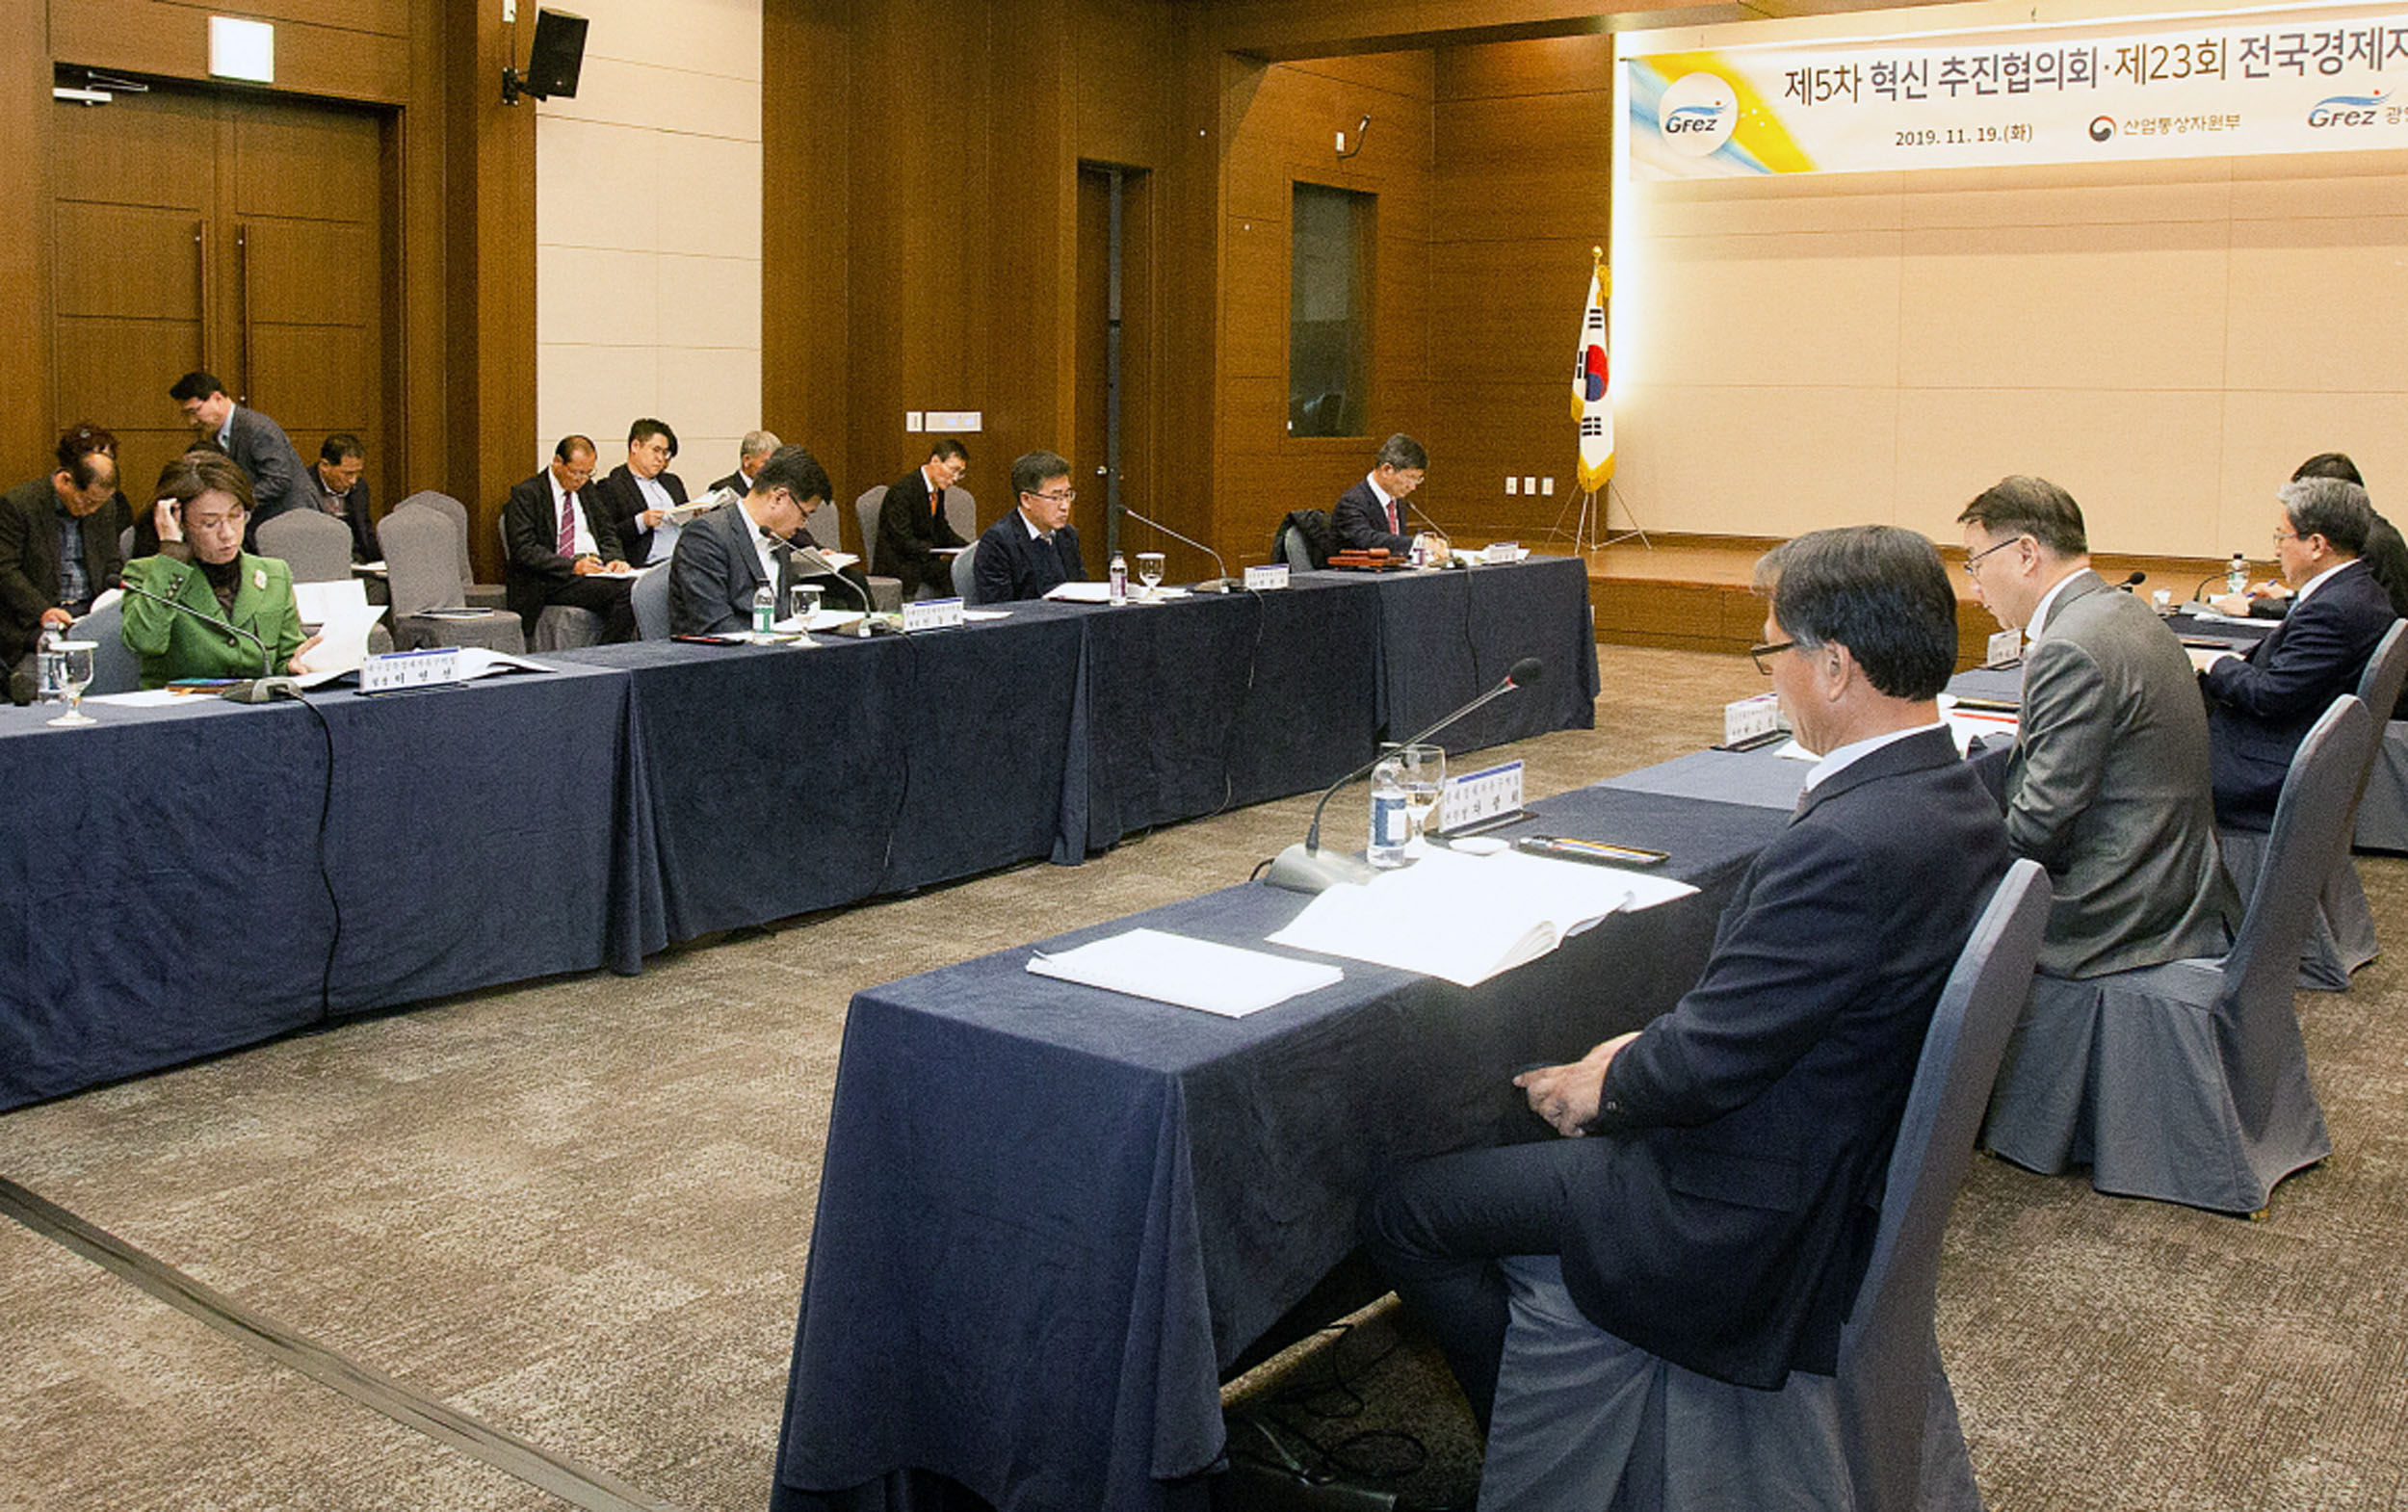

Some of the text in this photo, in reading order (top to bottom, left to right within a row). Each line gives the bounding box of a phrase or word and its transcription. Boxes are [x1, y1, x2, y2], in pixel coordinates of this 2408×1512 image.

[1784, 63, 1863, 106] 제5차
[1870, 58, 1928, 102] 혁신
[2123, 114, 2241, 136] 산업통상자원부
[2386, 106, 2408, 125] 광
[1895, 129, 1940, 146] 2019.
[1946, 128, 1972, 144] 11.
